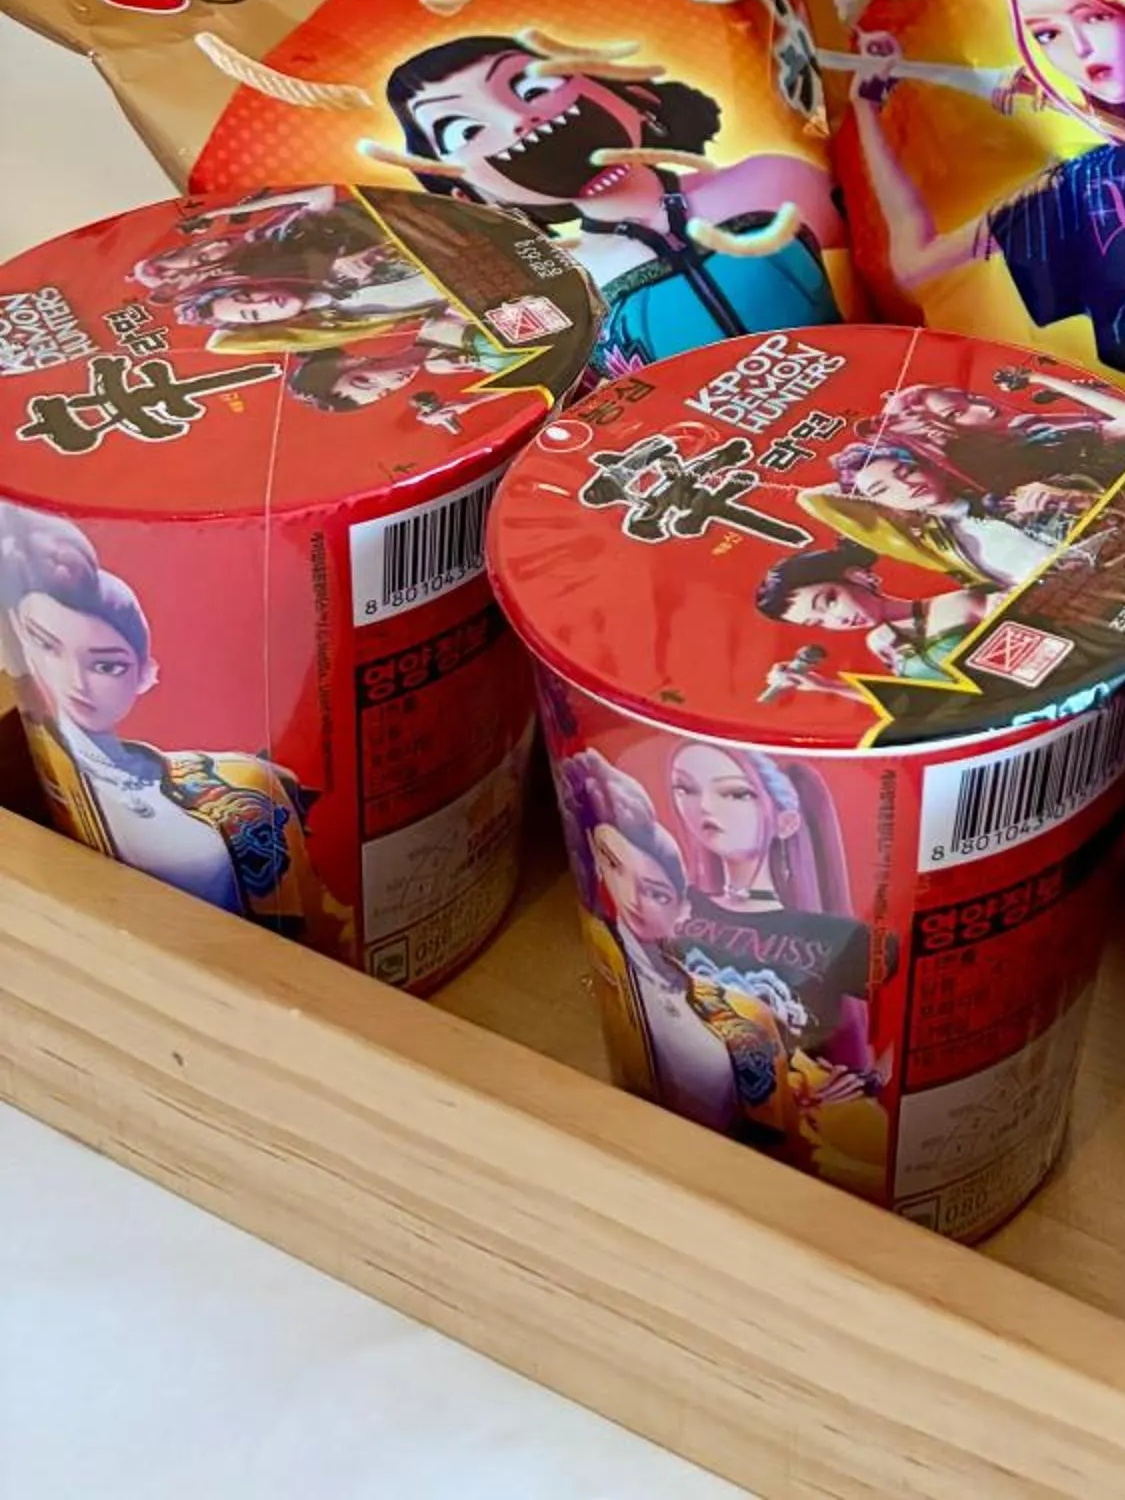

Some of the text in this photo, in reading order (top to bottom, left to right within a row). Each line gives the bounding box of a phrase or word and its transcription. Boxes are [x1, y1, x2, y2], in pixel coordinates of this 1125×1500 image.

[36, 286, 102, 361] HUNTERS
[102, 303, 170, 358] 라면
[16, 355, 284, 454] 辛
[577, 378, 657, 425] 농심
[684, 334, 789, 415] KPOP
[711, 342, 827, 426] DEMON
[735, 354, 847, 435] HUNTERS
[756, 409, 847, 473] 라면
[579, 434, 814, 549] 辛
